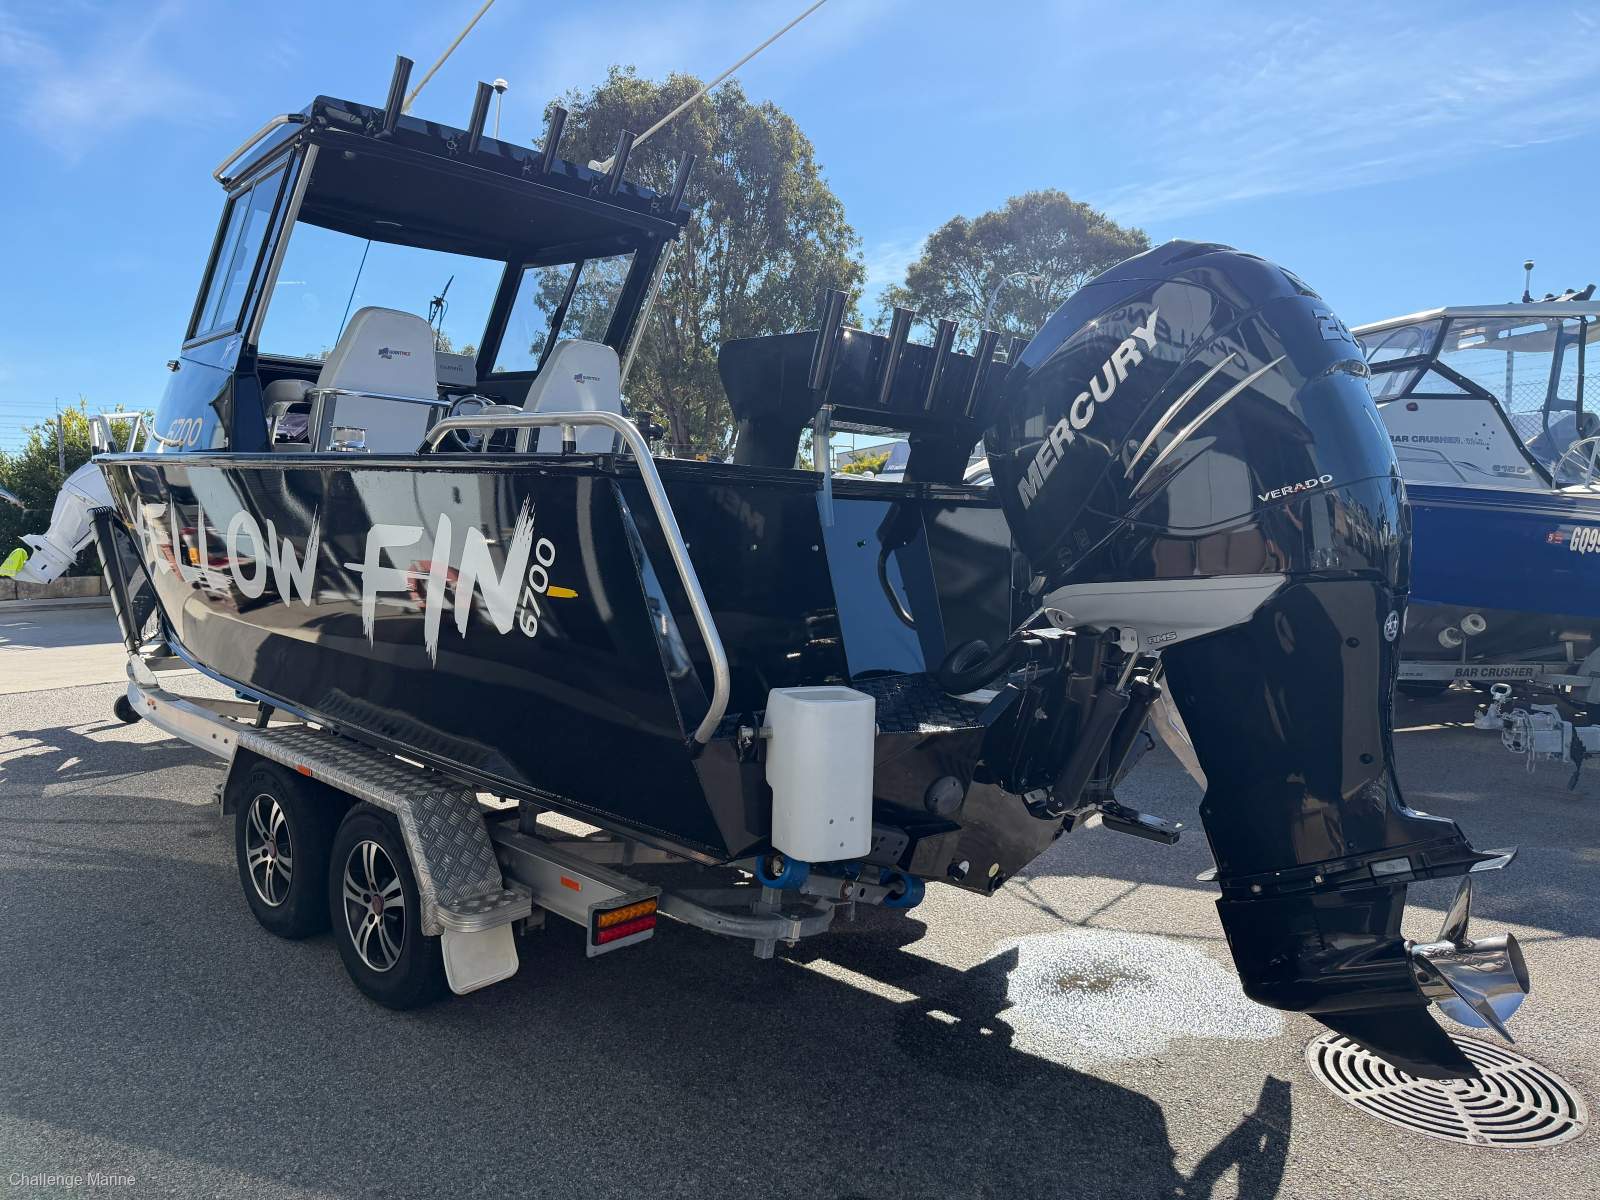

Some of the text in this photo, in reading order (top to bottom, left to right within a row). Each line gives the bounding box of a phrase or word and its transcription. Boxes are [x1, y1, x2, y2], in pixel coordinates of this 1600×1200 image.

[1017, 306, 1160, 510] MERCURY
[1257, 474, 1333, 502] VERADO
[124, 492, 536, 670] YELLOW FIN
[519, 537, 556, 638] 6700
[1454, 667, 1533, 678] BAR CRUSHER
